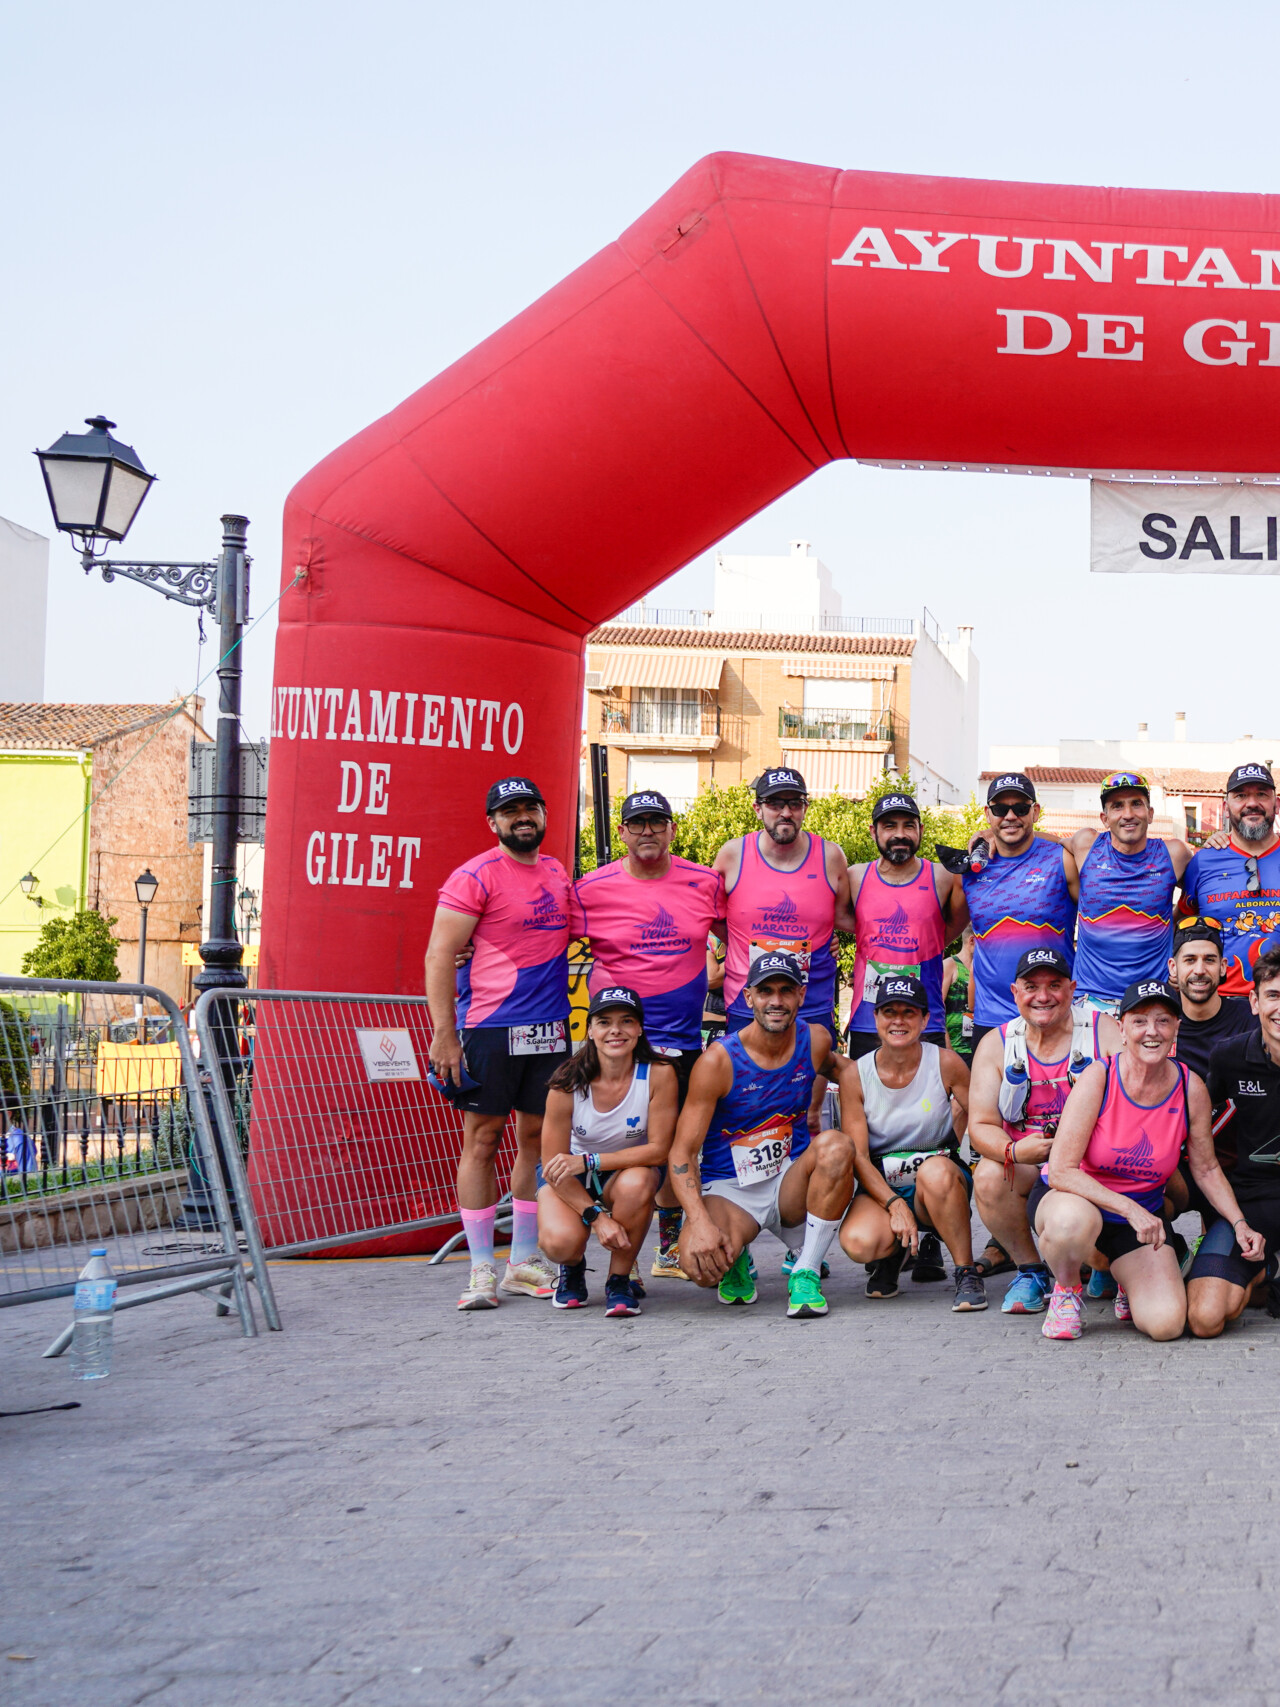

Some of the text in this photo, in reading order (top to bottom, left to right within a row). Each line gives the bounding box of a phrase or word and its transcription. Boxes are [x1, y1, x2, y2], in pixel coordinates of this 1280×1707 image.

[997, 307, 1145, 362] DE
[768, 771, 798, 785] E&L
[1236, 766, 1267, 779] E&L
[337, 760, 391, 815] DE
[499, 781, 532, 795] E&L
[995, 776, 1023, 789] E&L
[631, 795, 663, 807] E&L
[882, 796, 910, 809] E&L
[305, 830, 421, 889] GILET
[533, 902, 560, 916] velas
[1235, 900, 1280, 908] ALBORAYA
[522, 914, 568, 927] MARATON
[764, 911, 800, 924] velas
[641, 925, 679, 941] velas
[751, 923, 809, 934] MARATON
[879, 921, 910, 935] velas
[629, 937, 692, 952] MARATON
[868, 936, 919, 946] MARATON
[760, 956, 793, 969] E&L
[1027, 950, 1058, 962] E&L
[886, 980, 916, 994] E&L
[1137, 982, 1170, 997] E&L
[601, 989, 636, 1004] E&L
[526, 1020, 555, 1038] 311
[1238, 1080, 1265, 1093] E&L
[761, 1128, 779, 1138] GILET
[748, 1141, 783, 1165] 318
[1114, 1154, 1156, 1169] velas
[1098, 1164, 1163, 1179] MARATON
